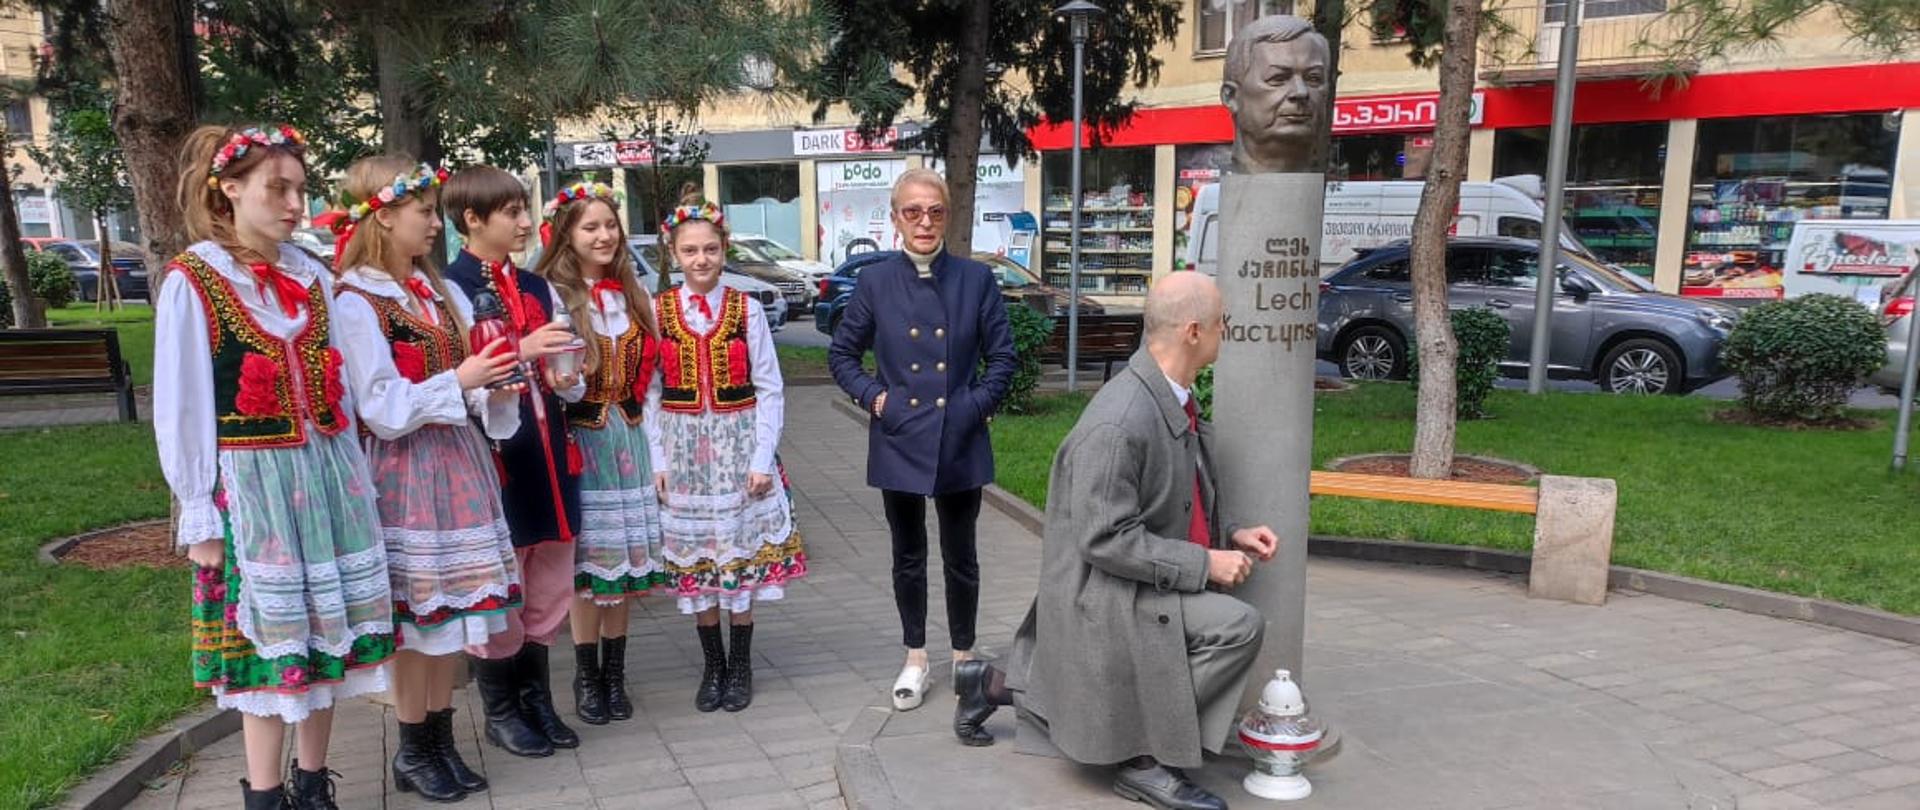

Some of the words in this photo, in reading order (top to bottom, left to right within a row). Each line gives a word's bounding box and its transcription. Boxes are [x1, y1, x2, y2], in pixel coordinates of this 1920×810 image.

[802, 135, 841, 151] DARK
[844, 163, 881, 180] bodo
[1266, 237, 1309, 257] ლეხ
[1256, 281, 1312, 311] Lech
